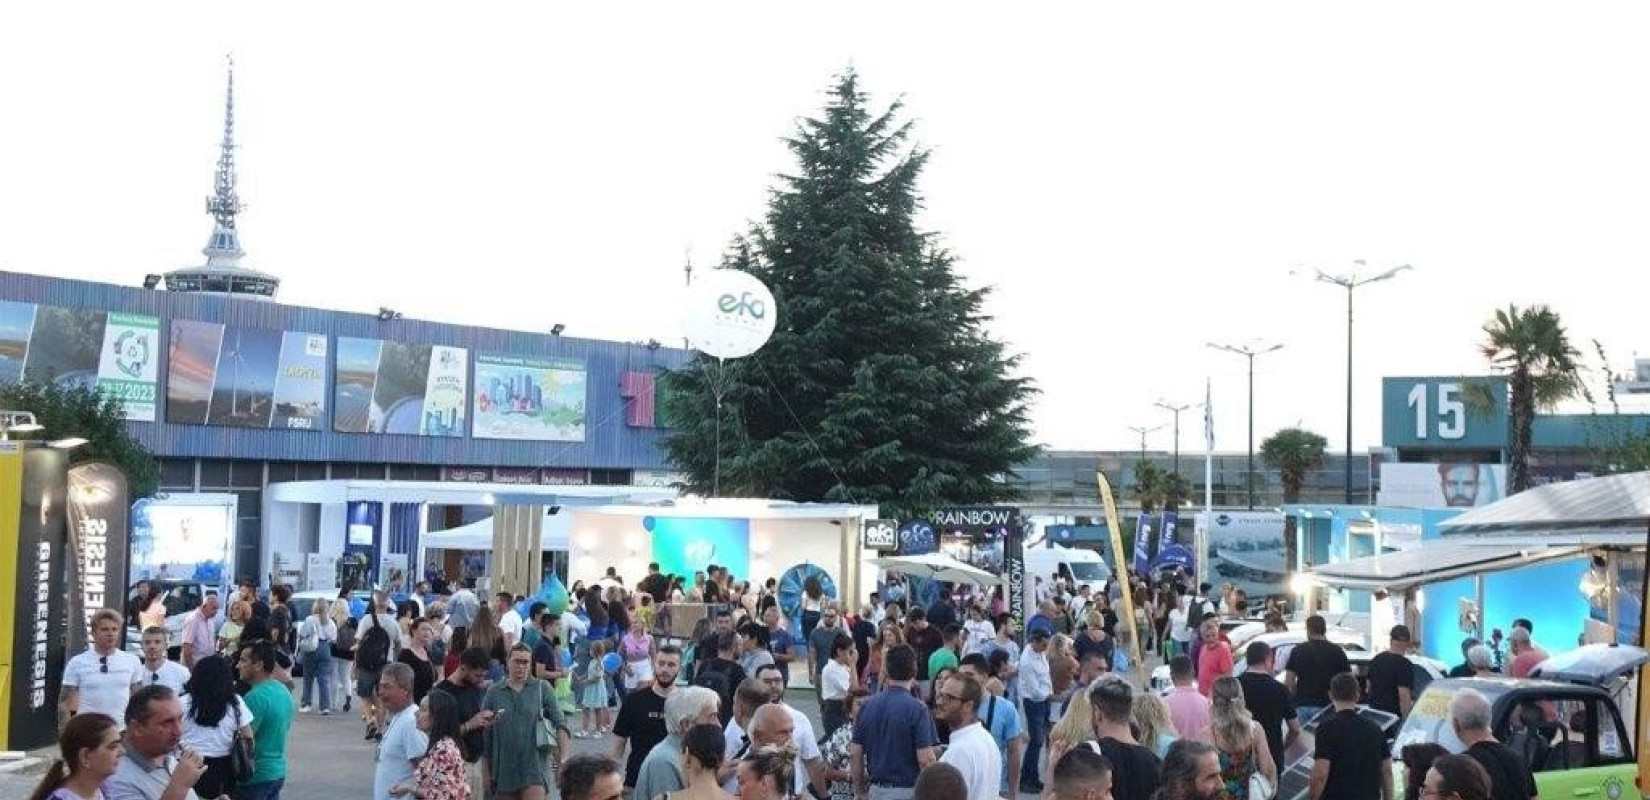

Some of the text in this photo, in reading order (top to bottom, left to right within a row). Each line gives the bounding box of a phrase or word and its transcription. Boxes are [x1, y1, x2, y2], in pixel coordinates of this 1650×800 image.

[717, 292, 765, 319] efa
[125, 383, 155, 401] 2023
[1407, 382, 1466, 440] 15
[936, 510, 1011, 525] RAINBOW
[1010, 558, 1024, 616] RAINBOW
